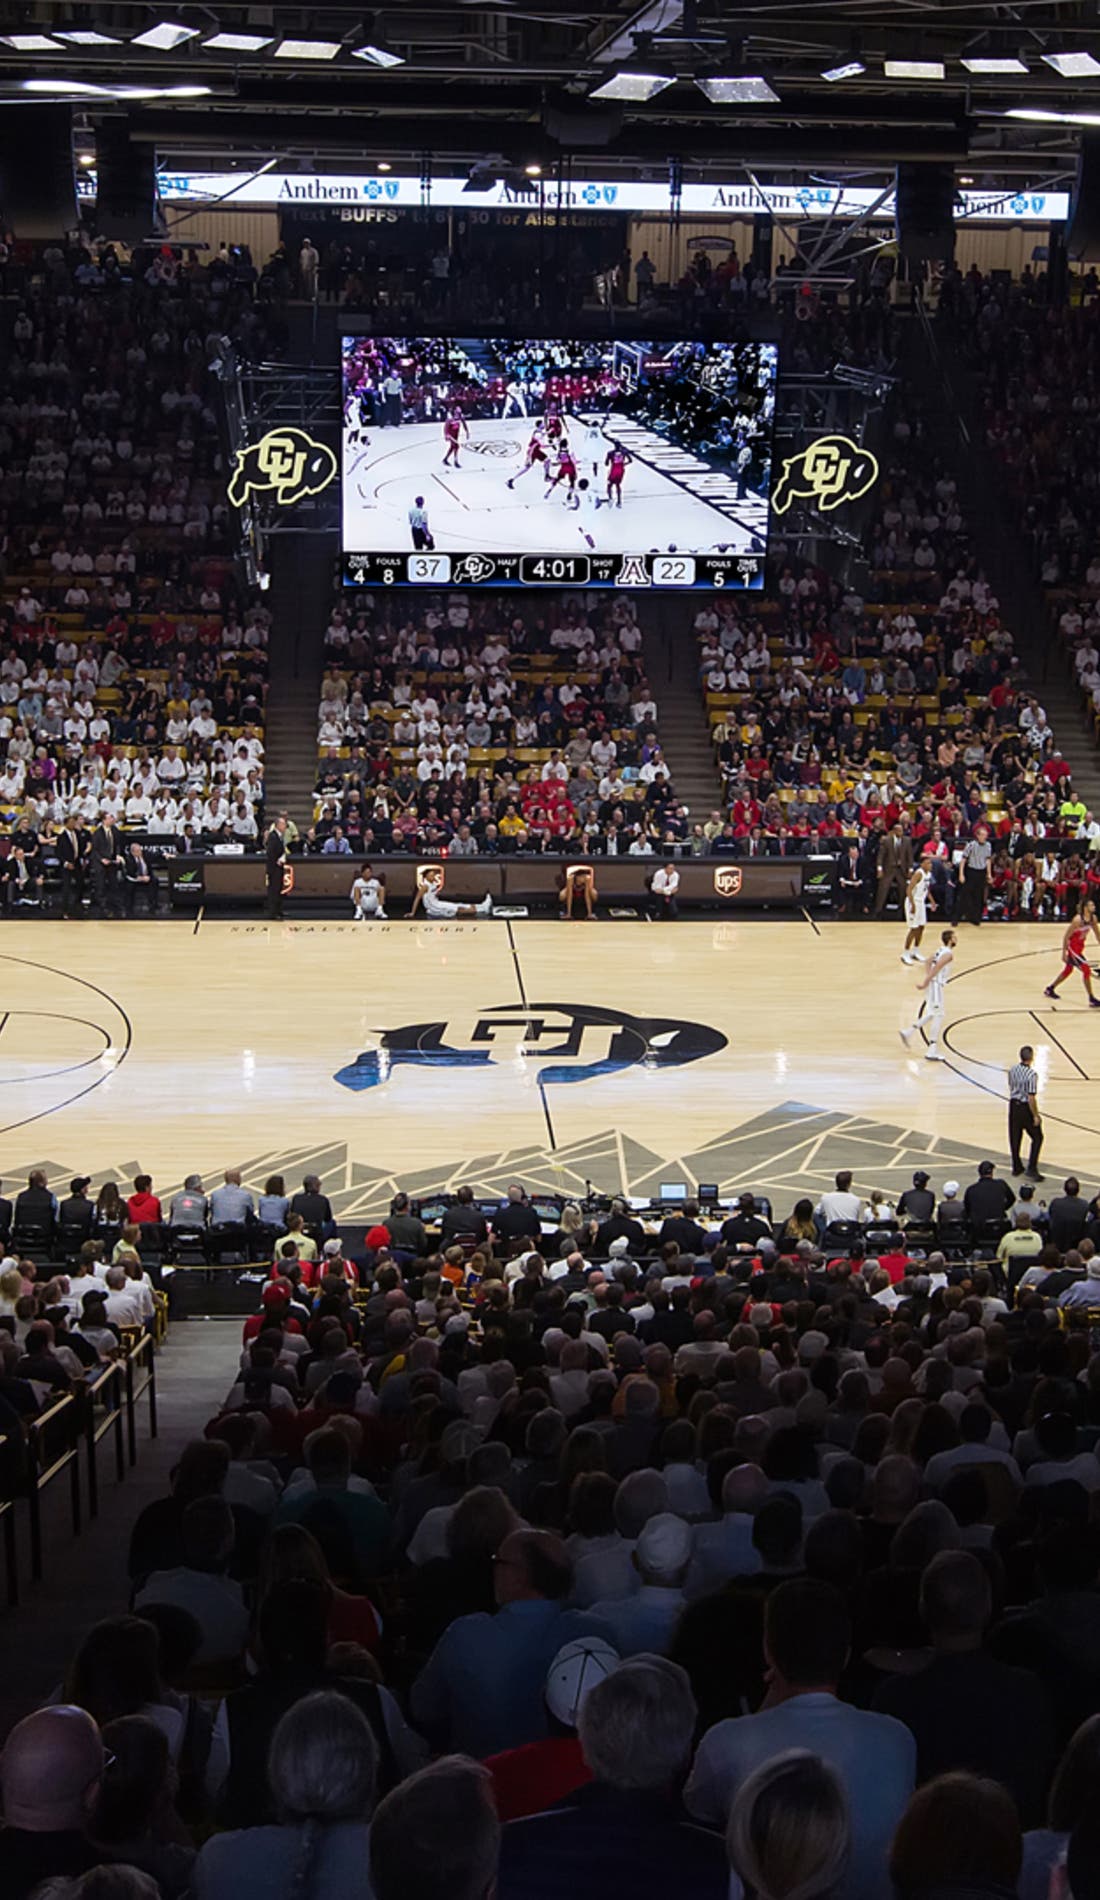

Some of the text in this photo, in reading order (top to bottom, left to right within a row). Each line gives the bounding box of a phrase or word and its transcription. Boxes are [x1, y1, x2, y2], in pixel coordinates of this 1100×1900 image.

[278, 178, 358, 199] Anthem
[497, 184, 577, 204] Anthem
[712, 187, 790, 208] Anthem
[376, 557, 402, 566] FOULS
[416, 559, 440, 577] 37
[532, 559, 575, 578] 4:01
[592, 559, 614, 567] SHOT
[706, 560, 731, 568] FOULS
[353, 568, 366, 585] 4
[383, 568, 394, 585] 8
[504, 567, 510, 579] 1
[598, 569, 610, 580] 17
[661, 561, 686, 580] 22
[713, 571, 725, 588] 5
[742, 572, 749, 588] 1
[717, 874, 740, 892] ups
